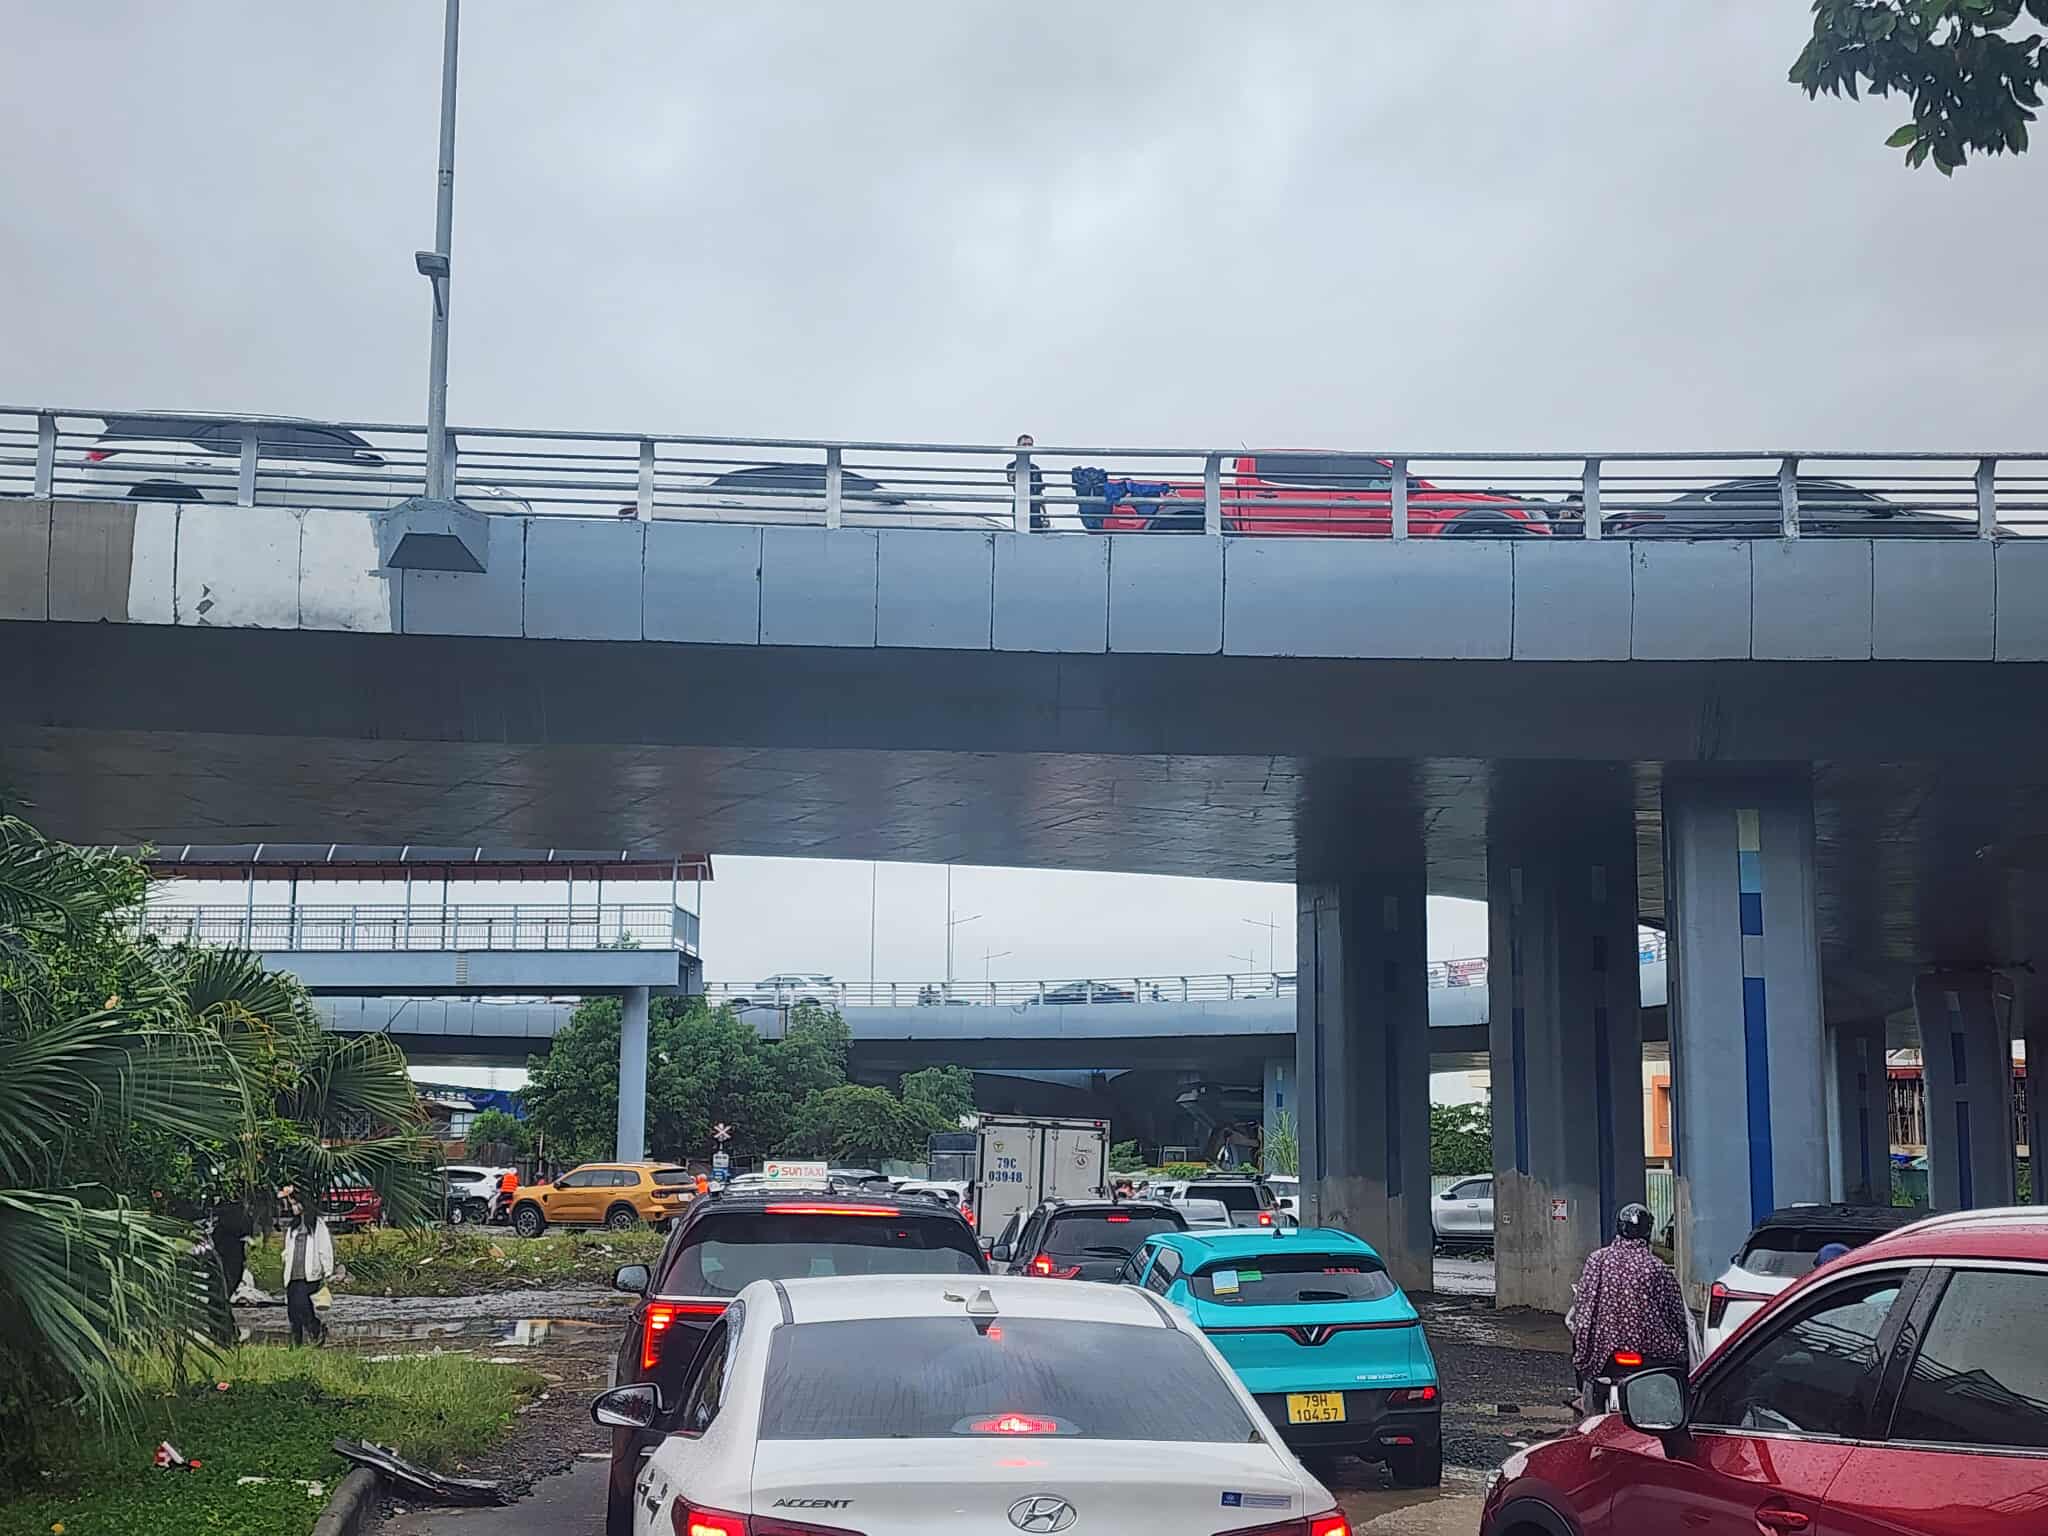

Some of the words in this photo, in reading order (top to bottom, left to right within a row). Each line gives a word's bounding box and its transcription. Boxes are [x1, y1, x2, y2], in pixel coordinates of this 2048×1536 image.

[997, 1157, 1017, 1169] 79C
[802, 1167, 824, 1177] TAXI
[1303, 1395, 1328, 1408] 79H
[1297, 1408, 1338, 1422] 104.57
[772, 1498, 855, 1509] ACCENT
